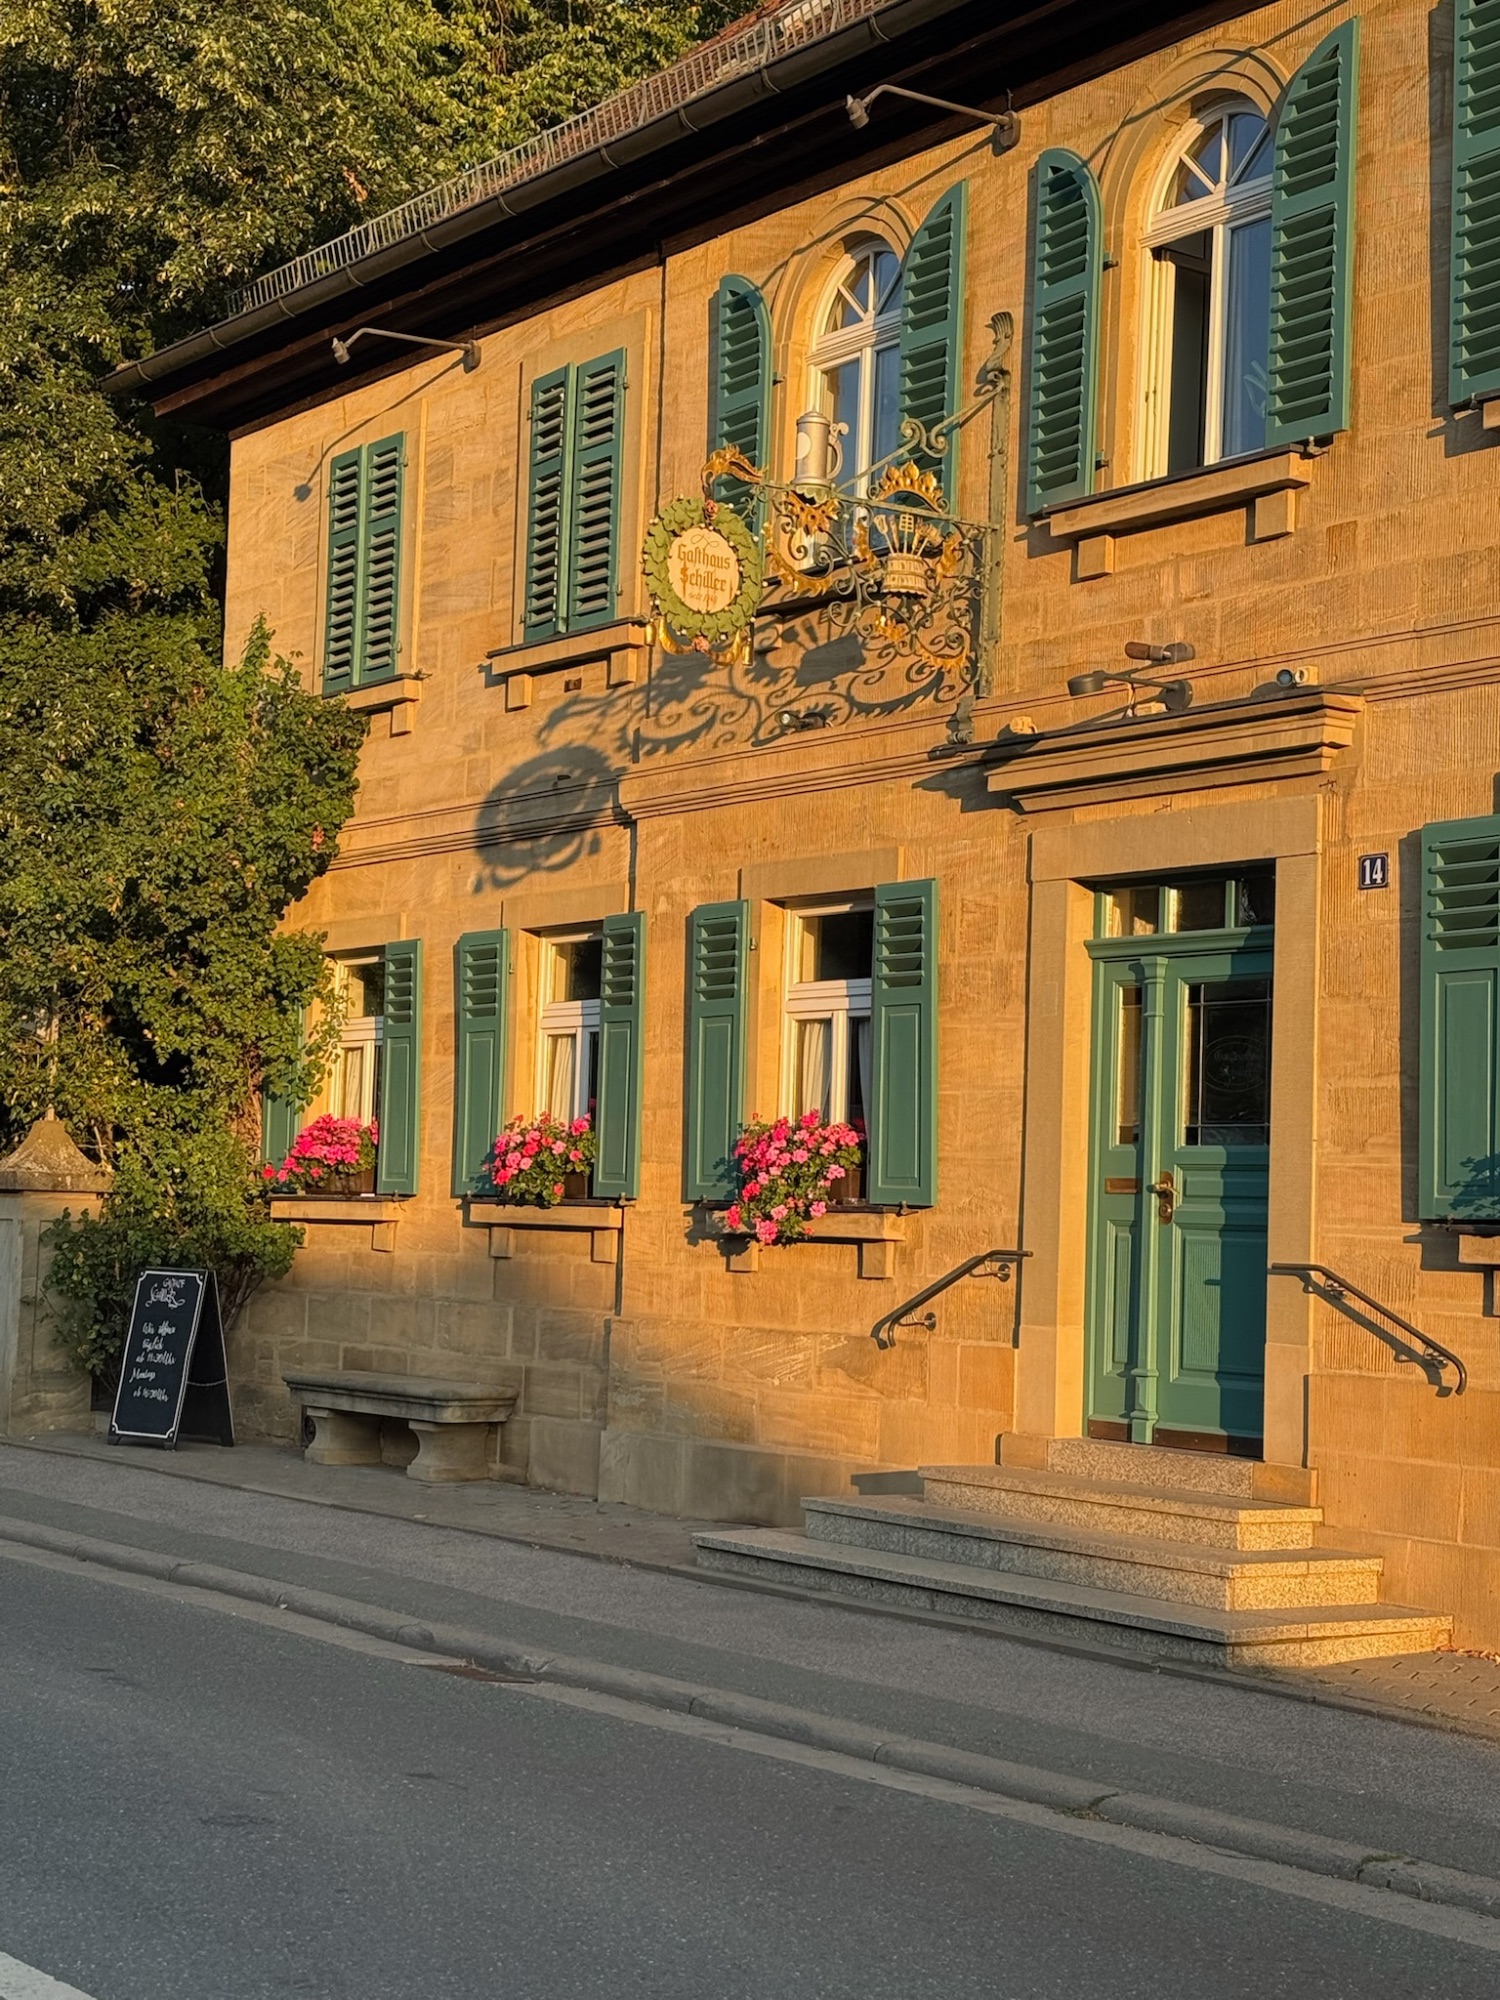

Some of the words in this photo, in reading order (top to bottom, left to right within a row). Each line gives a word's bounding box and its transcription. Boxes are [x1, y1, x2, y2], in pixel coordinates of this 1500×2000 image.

[677, 543, 731, 570] Gasthaus
[680, 567, 727, 592] Schiller
[1363, 858, 1383, 885] 14
